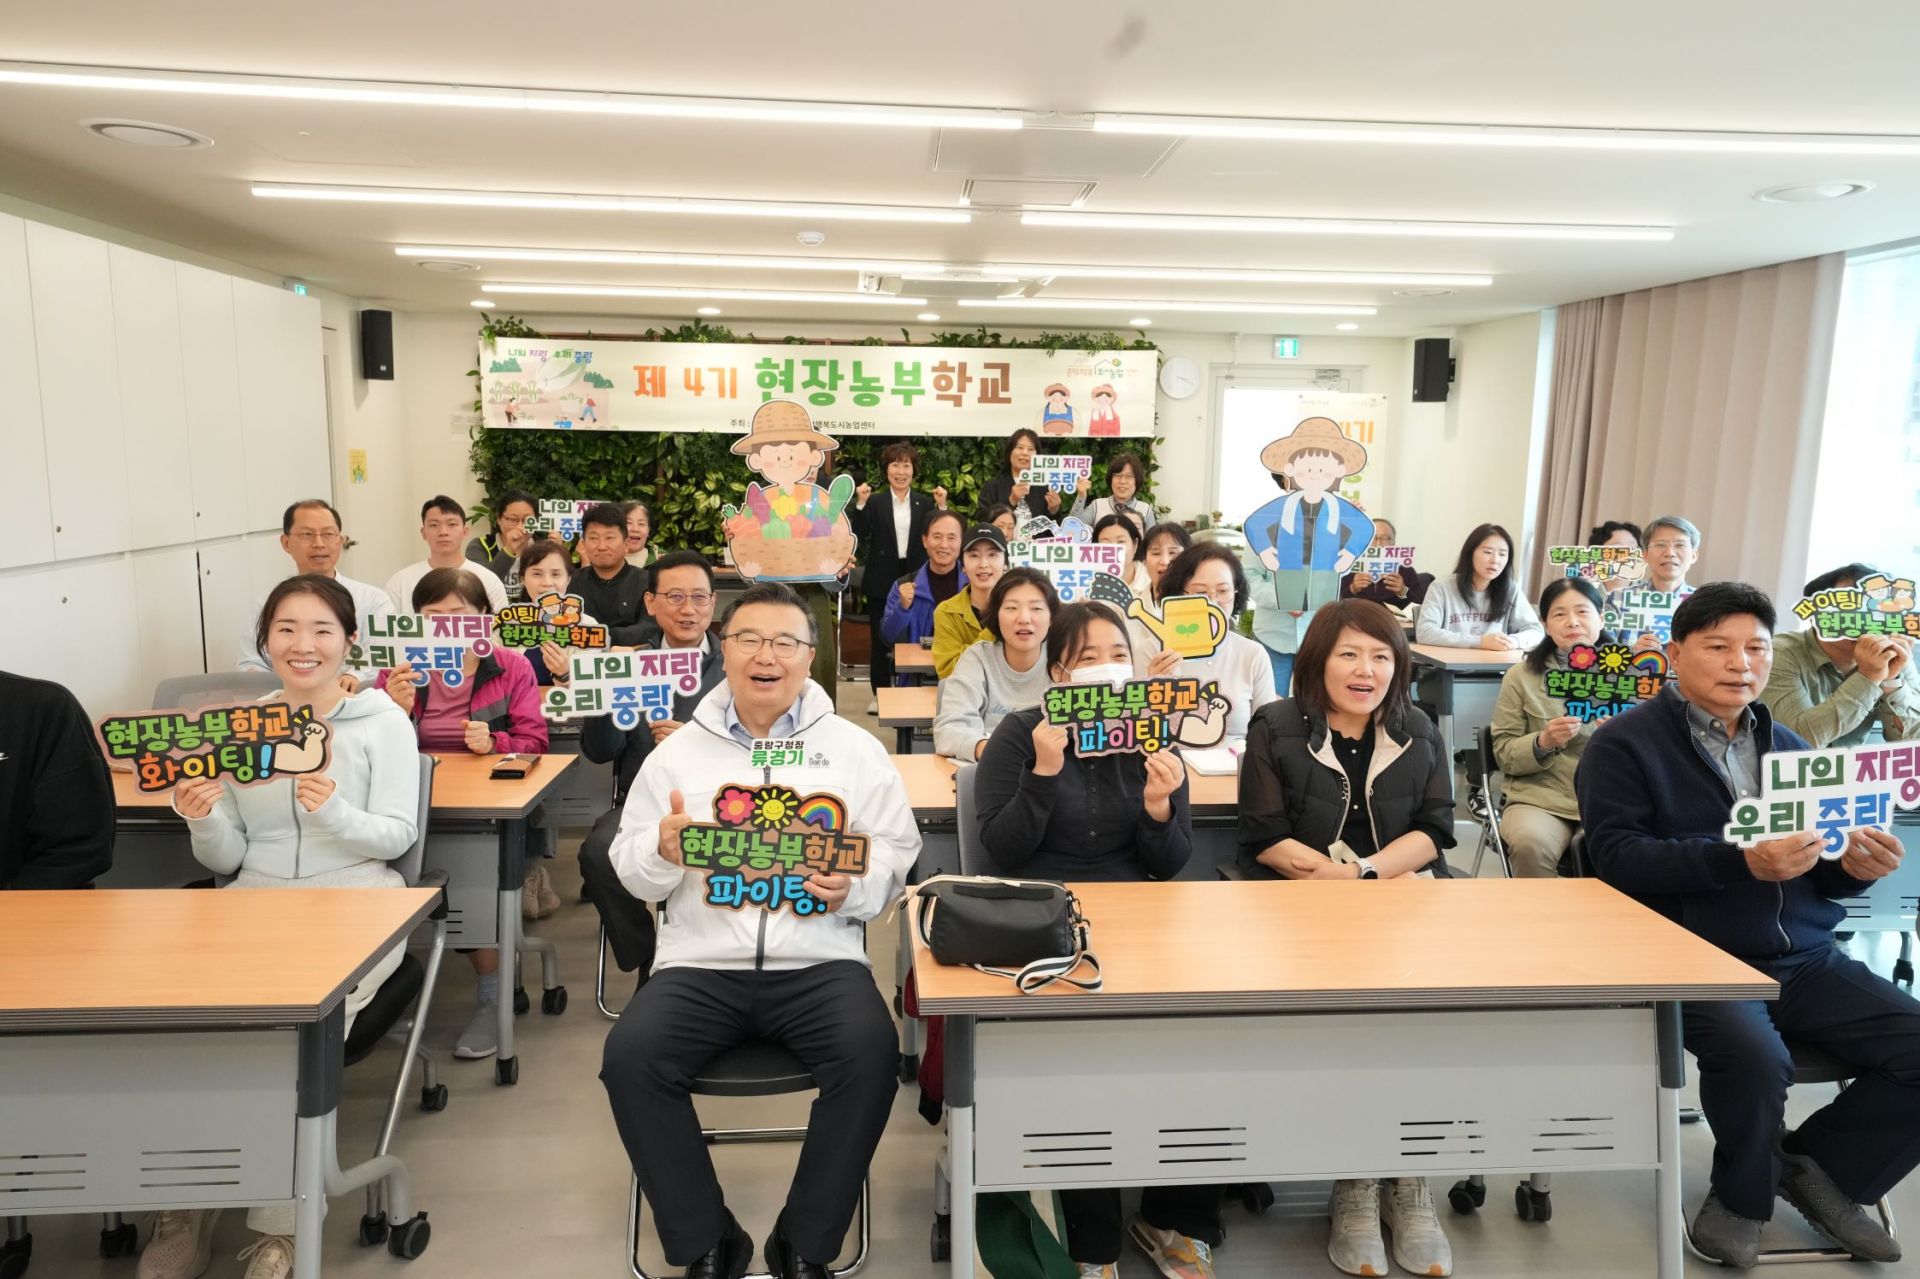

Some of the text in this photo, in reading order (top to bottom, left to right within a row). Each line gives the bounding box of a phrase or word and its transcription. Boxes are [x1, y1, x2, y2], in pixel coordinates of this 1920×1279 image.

[508, 348, 593, 364] 나의 자랑 우리 중랑
[633, 364, 738, 400] 제 4기
[754, 356, 1012, 408] 현장농부학교
[813, 420, 876, 430] 행복도시농업센터
[1033, 457, 1091, 477] 나의 자랑
[1048, 472, 1077, 492] 중랑
[540, 500, 572, 513] 나의
[524, 517, 555, 532] 우리
[1032, 546, 1124, 577] 나의 자랑
[1385, 547, 1416, 567] 자랑
[1625, 592, 1672, 609] 나의
[1794, 590, 1862, 619] 파이팅!
[368, 614, 494, 656] 나의 자랑
[502, 624, 606, 648] 현장농부학교
[1604, 612, 1645, 631] 우리
[345, 644, 465, 687] 우리 중랑
[573, 652, 700, 692] 나의 자랑
[545, 684, 671, 726] 우리 중랑
[1046, 680, 1198, 723] 현장농부학교
[105, 706, 292, 755] 현장농부학교
[1080, 715, 1168, 752] 파이팅!
[139, 744, 272, 789] 화이팅!
[752, 750, 804, 767] 류경기
[1771, 746, 1920, 803] 나의 자랑
[1729, 792, 1891, 853] 우리 중랑
[683, 828, 864, 872] 현장농부학교
